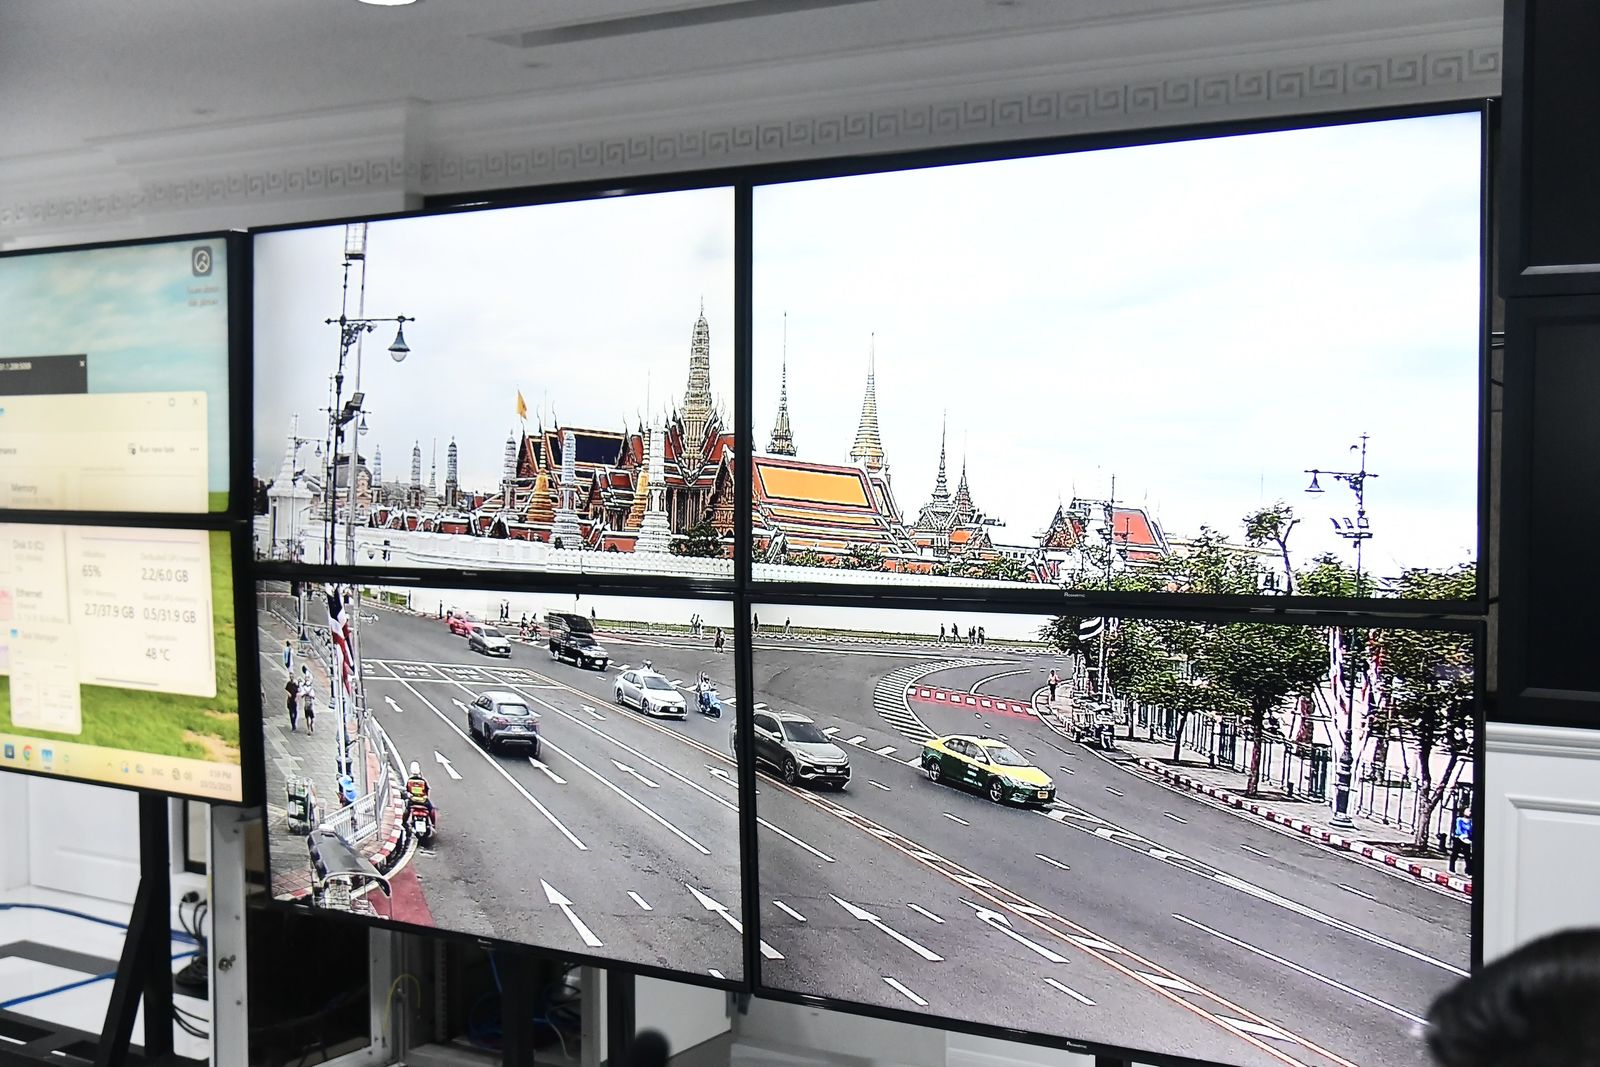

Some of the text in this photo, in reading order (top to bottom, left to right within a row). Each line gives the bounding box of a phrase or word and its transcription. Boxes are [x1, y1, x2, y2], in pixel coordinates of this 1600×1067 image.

[11, 483, 38, 494] Memory
[82, 564, 101, 577] 65%
[141, 567, 189, 583] 2.2/6.0 GB
[121, 605, 135, 619] GB
[143, 607, 197, 624] 0.5/31.9 GB
[145, 647, 171, 661] 48 °C
